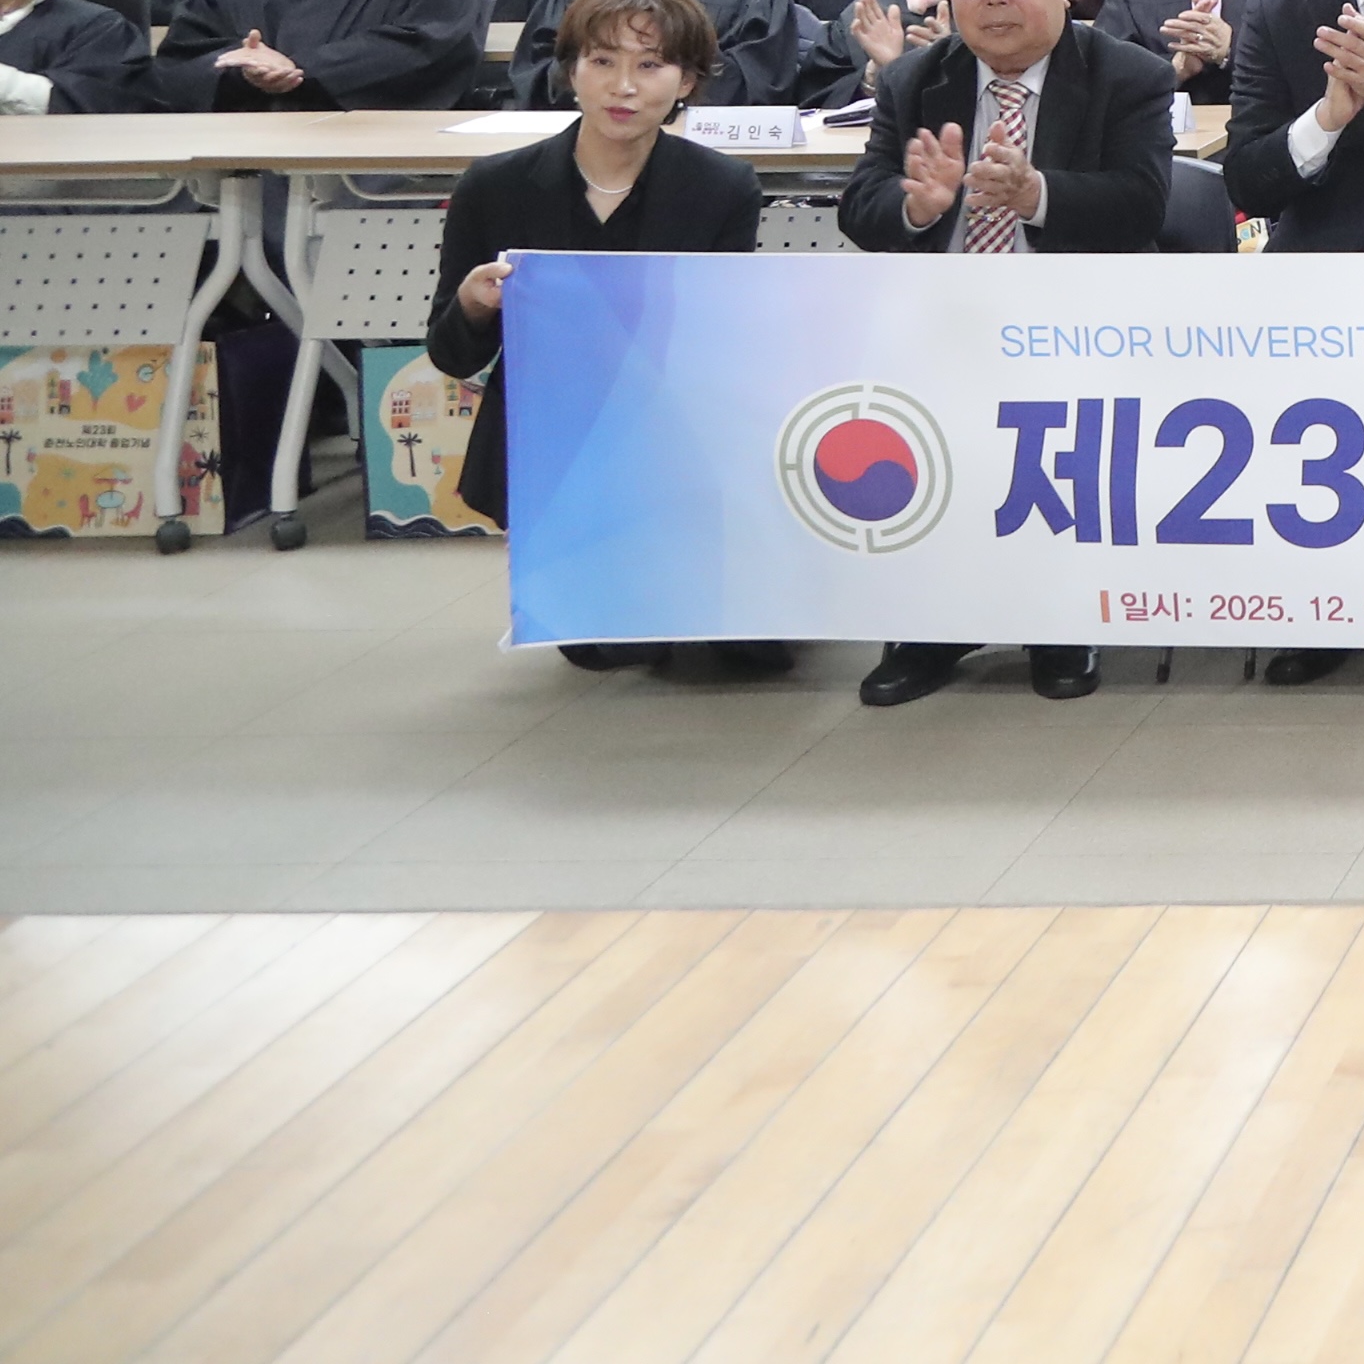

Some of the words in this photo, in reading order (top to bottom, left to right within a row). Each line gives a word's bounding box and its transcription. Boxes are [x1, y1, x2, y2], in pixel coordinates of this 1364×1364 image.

[727, 124, 782, 140] 김인숙
[1001, 325, 1153, 358] SENIOR
[81, 424, 116, 435] 제23회
[1120, 592, 1193, 623] 일시:
[1209, 595, 1294, 623] 2025.
[1309, 595, 1354, 623] 12.
